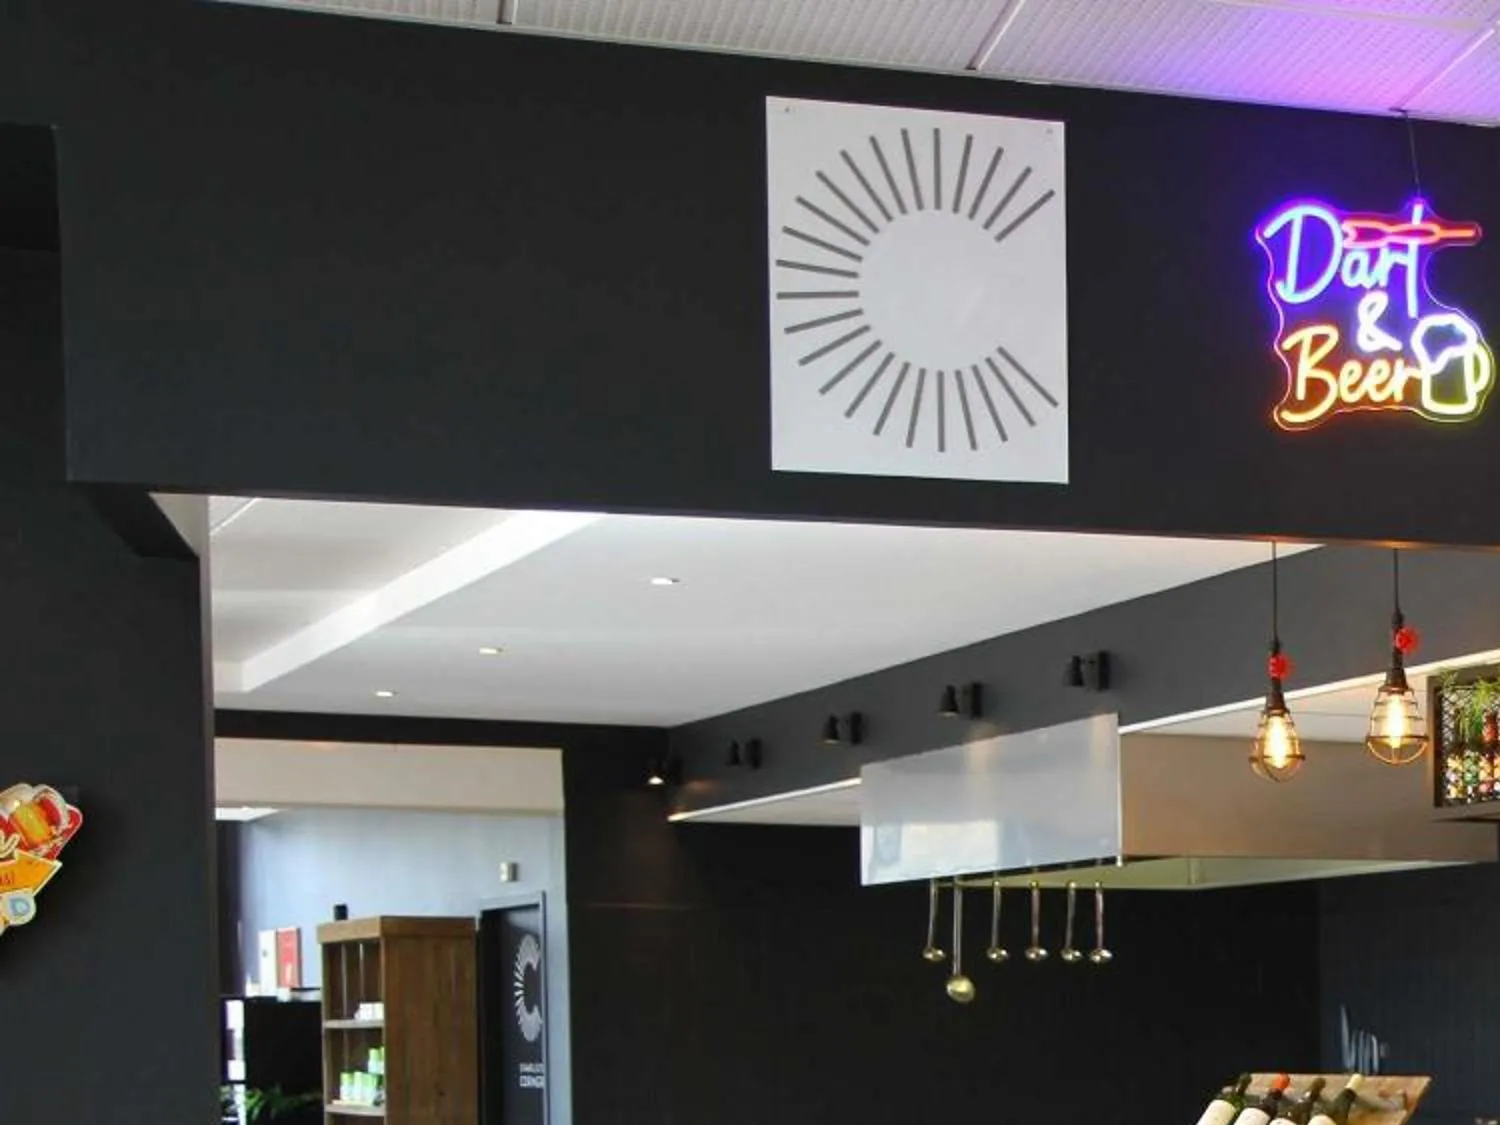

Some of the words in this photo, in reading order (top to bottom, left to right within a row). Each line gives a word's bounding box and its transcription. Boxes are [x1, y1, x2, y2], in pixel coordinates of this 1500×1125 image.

[1263, 203, 1424, 319] Dart
[1357, 290, 1403, 353] &
[1281, 323, 1423, 423] Beer
